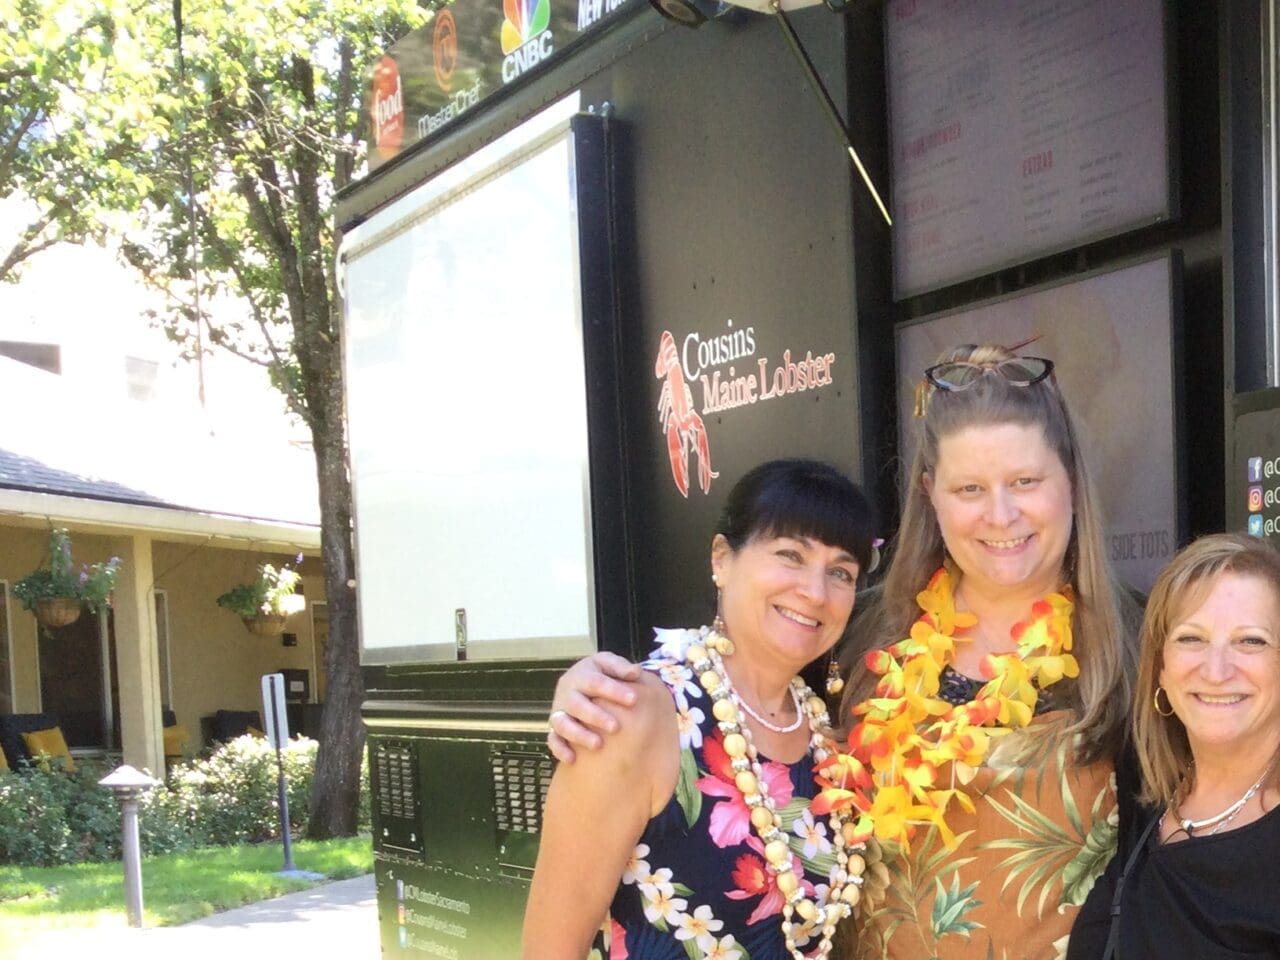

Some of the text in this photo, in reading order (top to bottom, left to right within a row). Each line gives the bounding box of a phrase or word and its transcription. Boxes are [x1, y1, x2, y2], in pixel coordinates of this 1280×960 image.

[502, 30, 553, 83] CNBC
[375, 75, 403, 145] food
[682, 319, 756, 382] Cousins
[700, 349, 836, 415] Maine Lobster
[1141, 529, 1169, 560] TOTS
